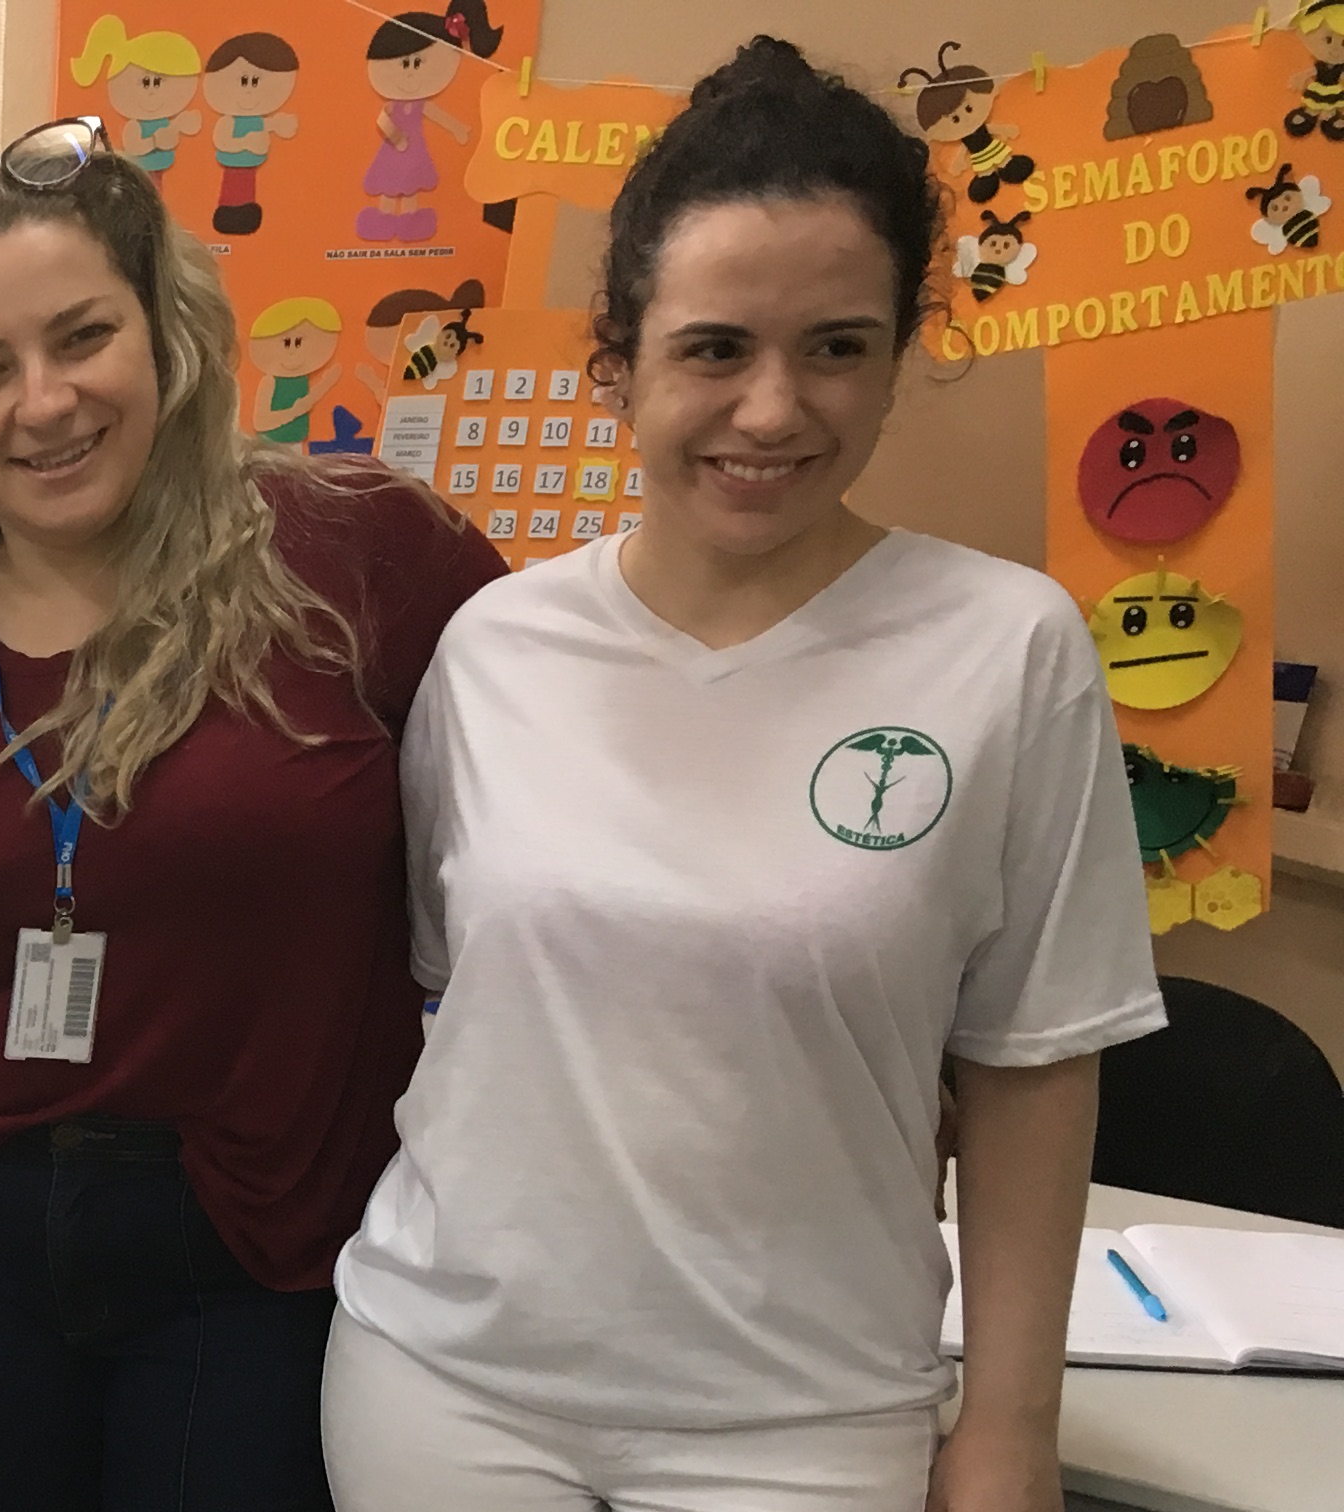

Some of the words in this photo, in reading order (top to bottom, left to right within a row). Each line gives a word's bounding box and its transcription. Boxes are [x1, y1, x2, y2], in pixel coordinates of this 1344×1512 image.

[1123, 213, 1190, 264] DO
[474, 376, 485, 395] 1
[514, 376, 528, 395] 2
[558, 377, 570, 396] 3
[467, 422, 480, 440] 8
[507, 420, 520, 439] 9
[543, 421, 569, 440] 10
[588, 425, 613, 444] 11
[453, 470, 476, 489] 15
[495, 470, 519, 488] 16
[538, 471, 564, 489] 17
[582, 470, 608, 489] 18
[490, 516, 515, 535] 23
[530, 516, 556, 534] 24
[576, 516, 602, 534] 25
[836, 823, 906, 847] ESTÉTICA
